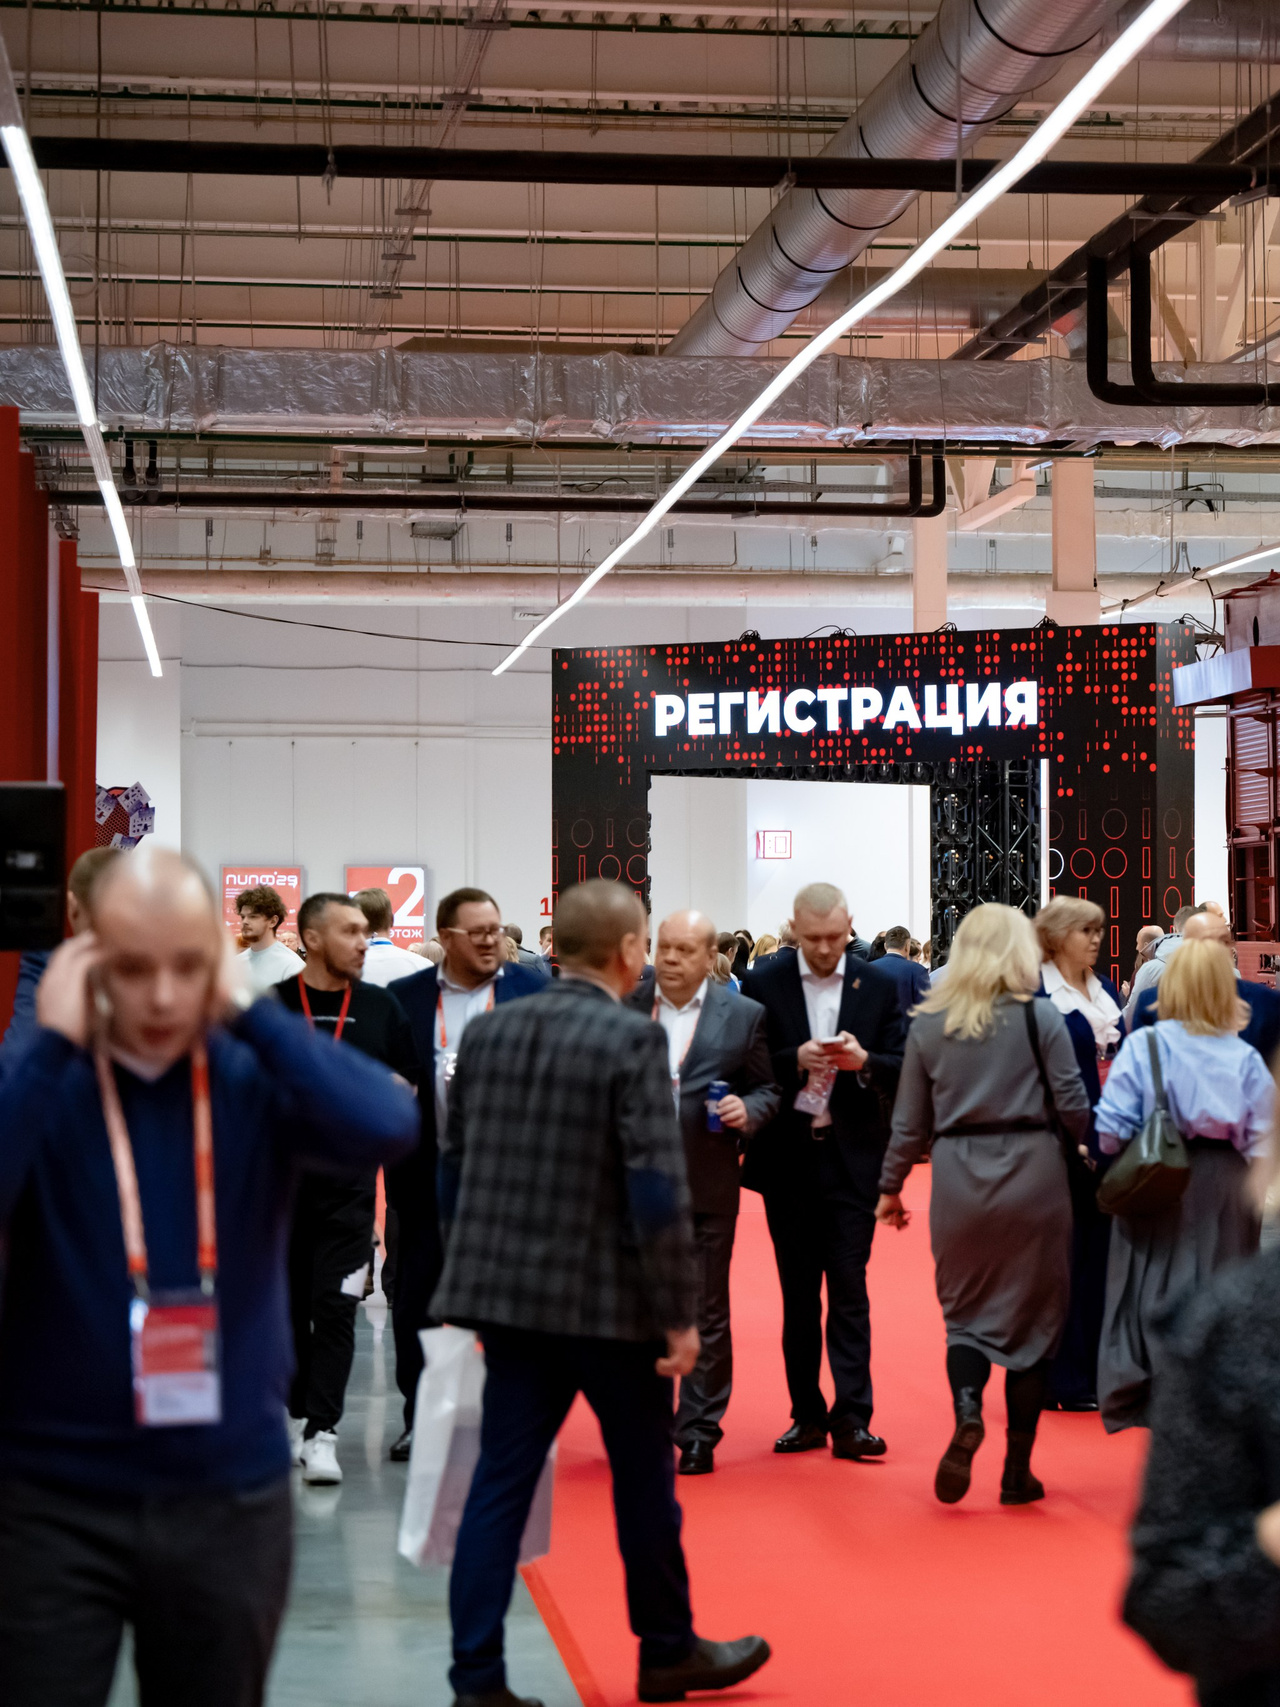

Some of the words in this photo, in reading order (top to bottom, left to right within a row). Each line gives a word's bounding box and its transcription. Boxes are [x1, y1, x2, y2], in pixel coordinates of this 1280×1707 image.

[654, 680, 1038, 737] РЕГИСТРАЦИЯ
[387, 867, 424, 926] 2
[389, 928, 422, 938] этаж
